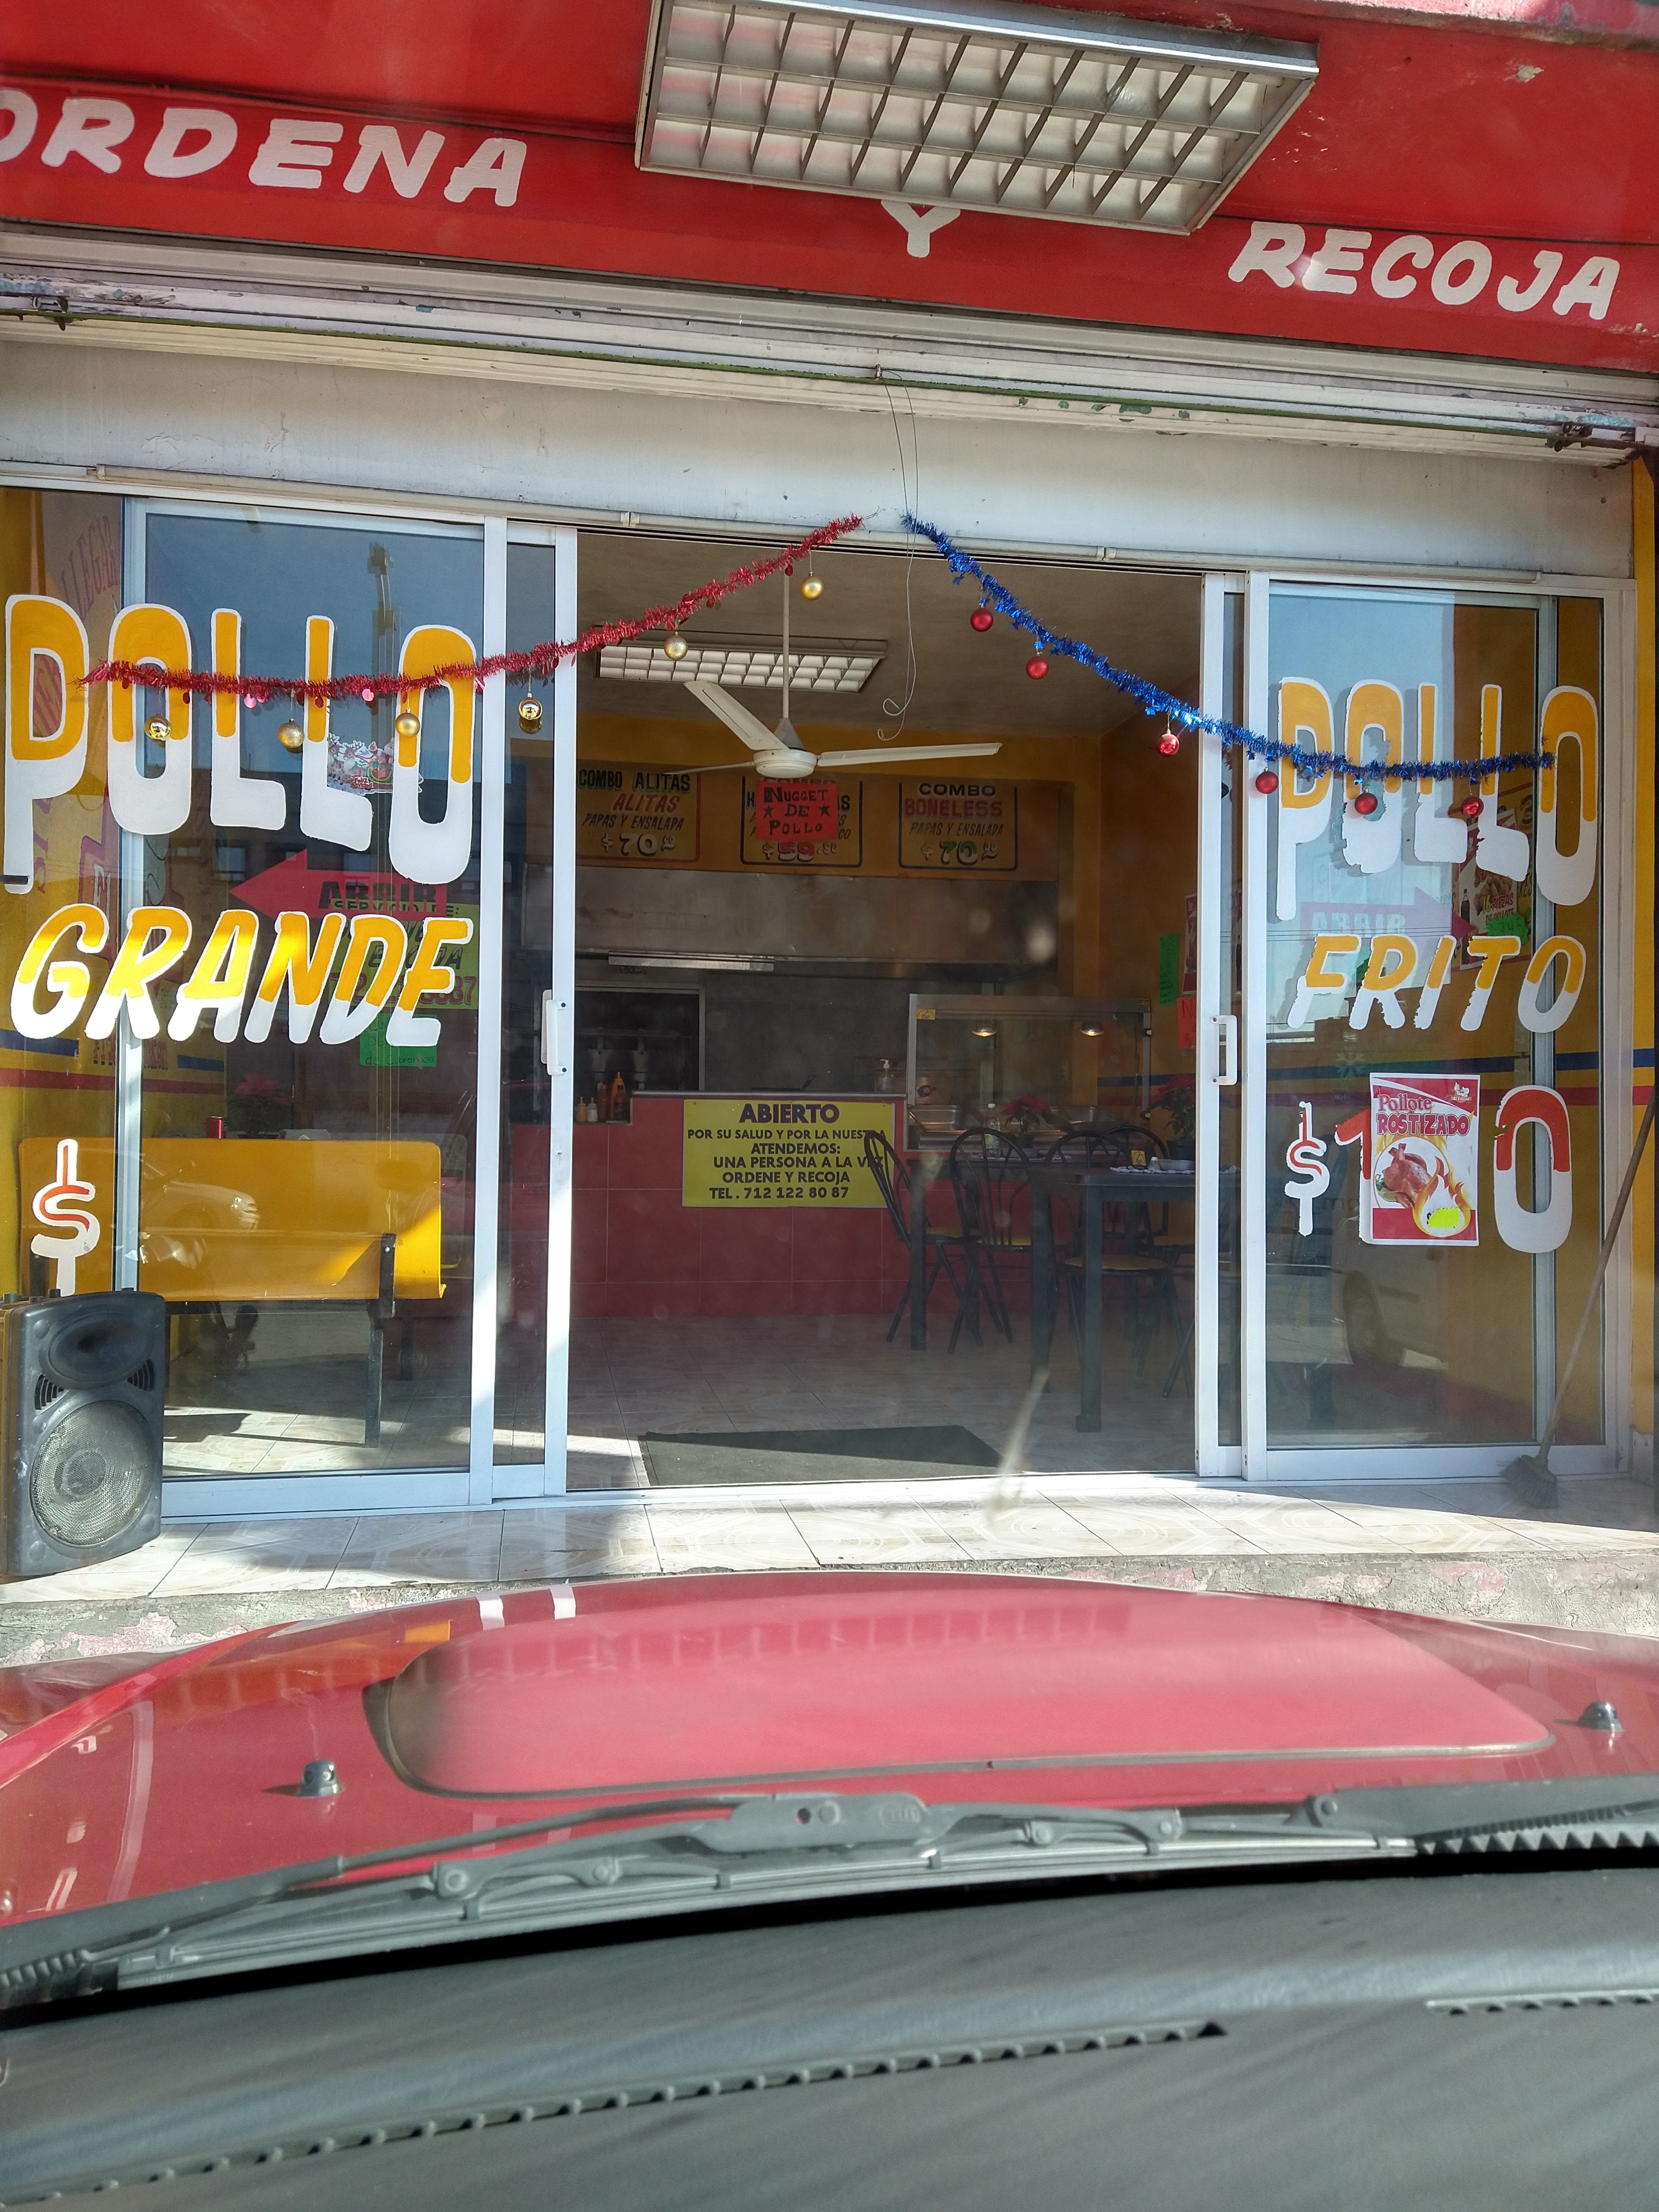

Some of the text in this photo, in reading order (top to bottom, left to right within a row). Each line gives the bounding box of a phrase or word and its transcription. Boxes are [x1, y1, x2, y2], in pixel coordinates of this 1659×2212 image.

[881, 198, 960, 258] Y
[1228, 221, 1621, 320] RECOJA
[3, 593, 477, 894] POLLO
[578, 769, 691, 792] COMBO ALITAS
[919, 782, 997, 797] COMBO
[612, 793, 681, 813] ALITAS
[904, 797, 1004, 818] BONELESS
[1276, 676, 1599, 921] POLLO
[784, 804, 810, 818] DE
[582, 813, 685, 831] PAPAS Y ENSALADA
[769, 820, 823, 836] POLLO
[909, 821, 1004, 837] PAPAS Y ENSALADA
[318, 880, 436, 912] ABRIR
[10, 902, 474, 1046] GRANDE
[1287, 933, 1586, 1034] FRITO
[1378, 1092, 1432, 1112] Pollote
[738, 1103, 840, 1124] ABIERTO
[687, 1129, 713, 1140] POR
[717, 1129, 732, 1140] SU
[735, 1129, 773, 1140] SALUD
[776, 1129, 784, 1140] Y
[787, 1129, 811, 1140] POR
[815, 1129, 830, 1140] LA
[1376, 1113, 1470, 1136] ROSTIZADO
[750, 1142, 841, 1155] ATENDEMOS:
[713, 1156, 746, 1168] UNA
[750, 1156, 816, 1168] PERSONA
[821, 1156, 832, 1168] A
[836, 1156, 852, 1168] LA
[722, 1171, 851, 1185] ORDENE Y RECOJA
[744, 1187, 771, 1199] 712
[776, 1187, 804, 1199] 122
[809, 1187, 827, 1199] 80
[832, 1187, 849, 1199] 87
[30, 1138, 100, 1296] $
